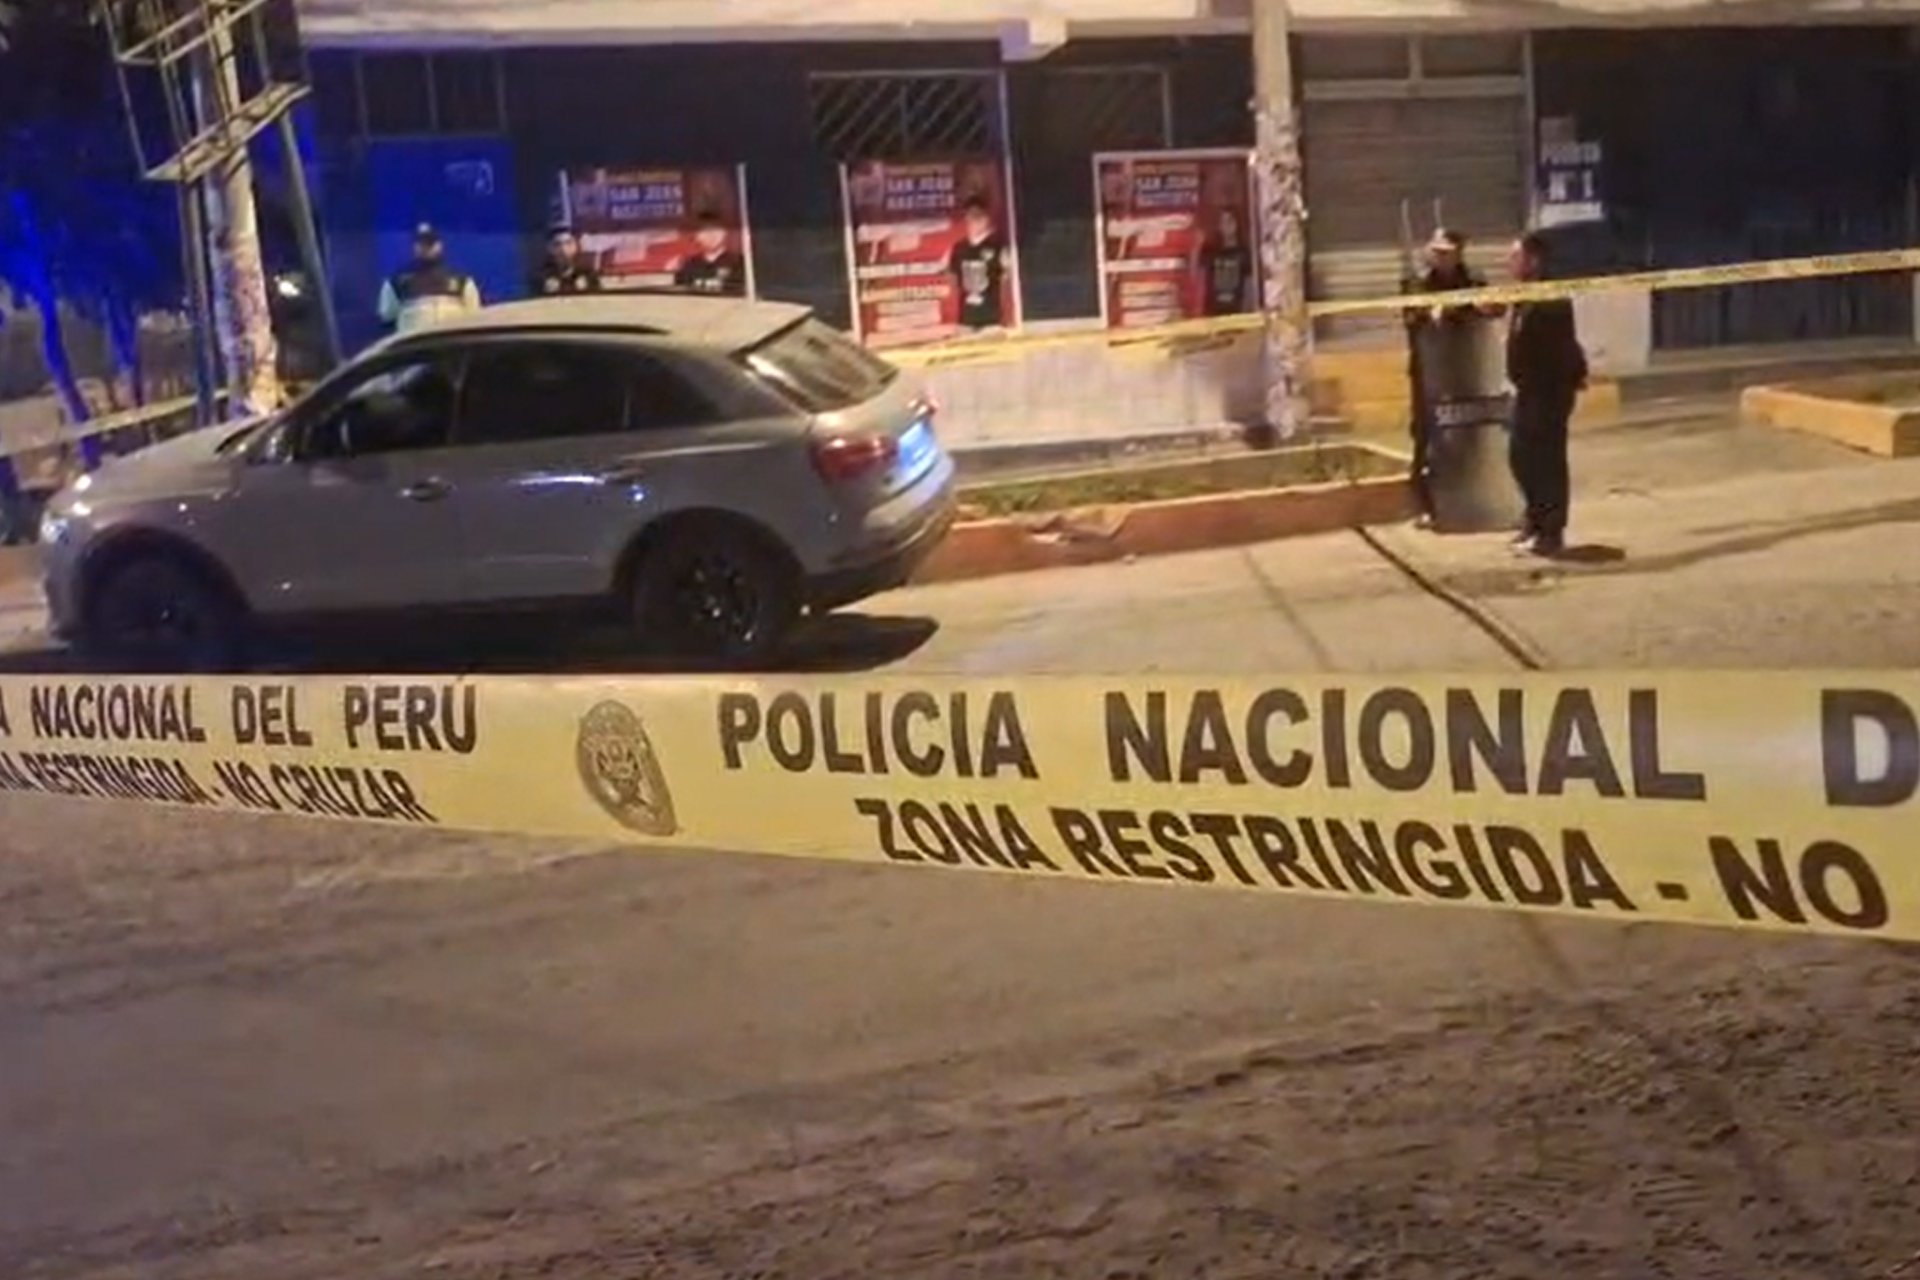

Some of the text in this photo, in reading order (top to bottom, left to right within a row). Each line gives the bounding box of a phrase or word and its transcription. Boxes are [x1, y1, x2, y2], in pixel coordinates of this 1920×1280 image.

[30, 684, 206, 743] NACIONAL
[232, 685, 313, 747] DEL
[718, 687, 1920, 806] POLICIA NACIONAL D
[19, 751, 218, 806] RESTRINGIDA
[213, 761, 281, 811] NO
[269, 763, 437, 823] CRUZAR
[854, 798, 1889, 929] ZONA RESTRINGIDA - NO
